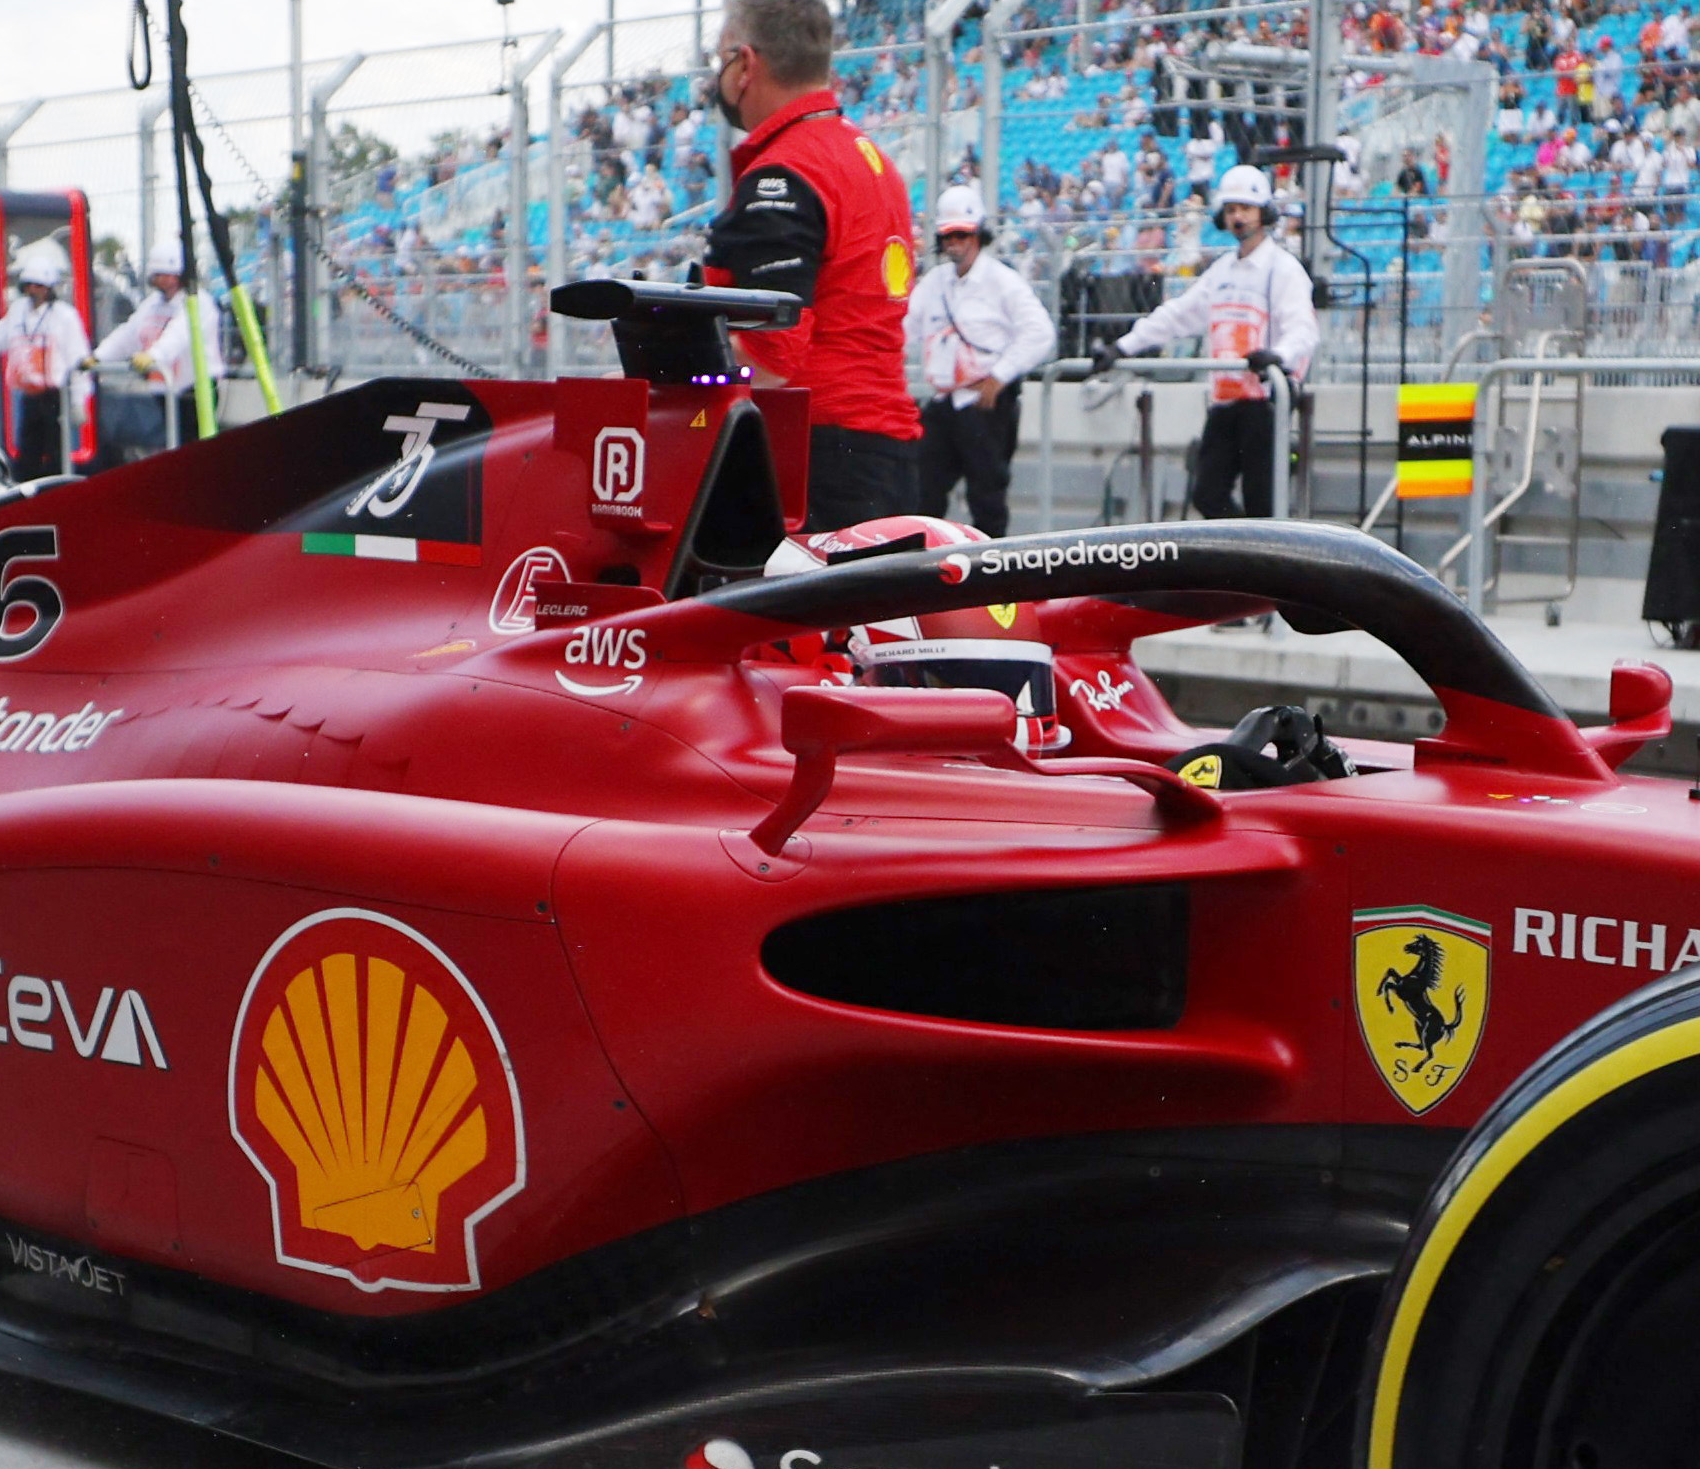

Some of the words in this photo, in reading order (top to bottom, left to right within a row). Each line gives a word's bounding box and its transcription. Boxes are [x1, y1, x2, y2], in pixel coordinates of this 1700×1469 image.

[980, 538, 1181, 576] Snapdragon
[535, 604, 589, 617] LECLERC
[563, 625, 646, 670] aws
[874, 648, 916, 658] RICHARD
